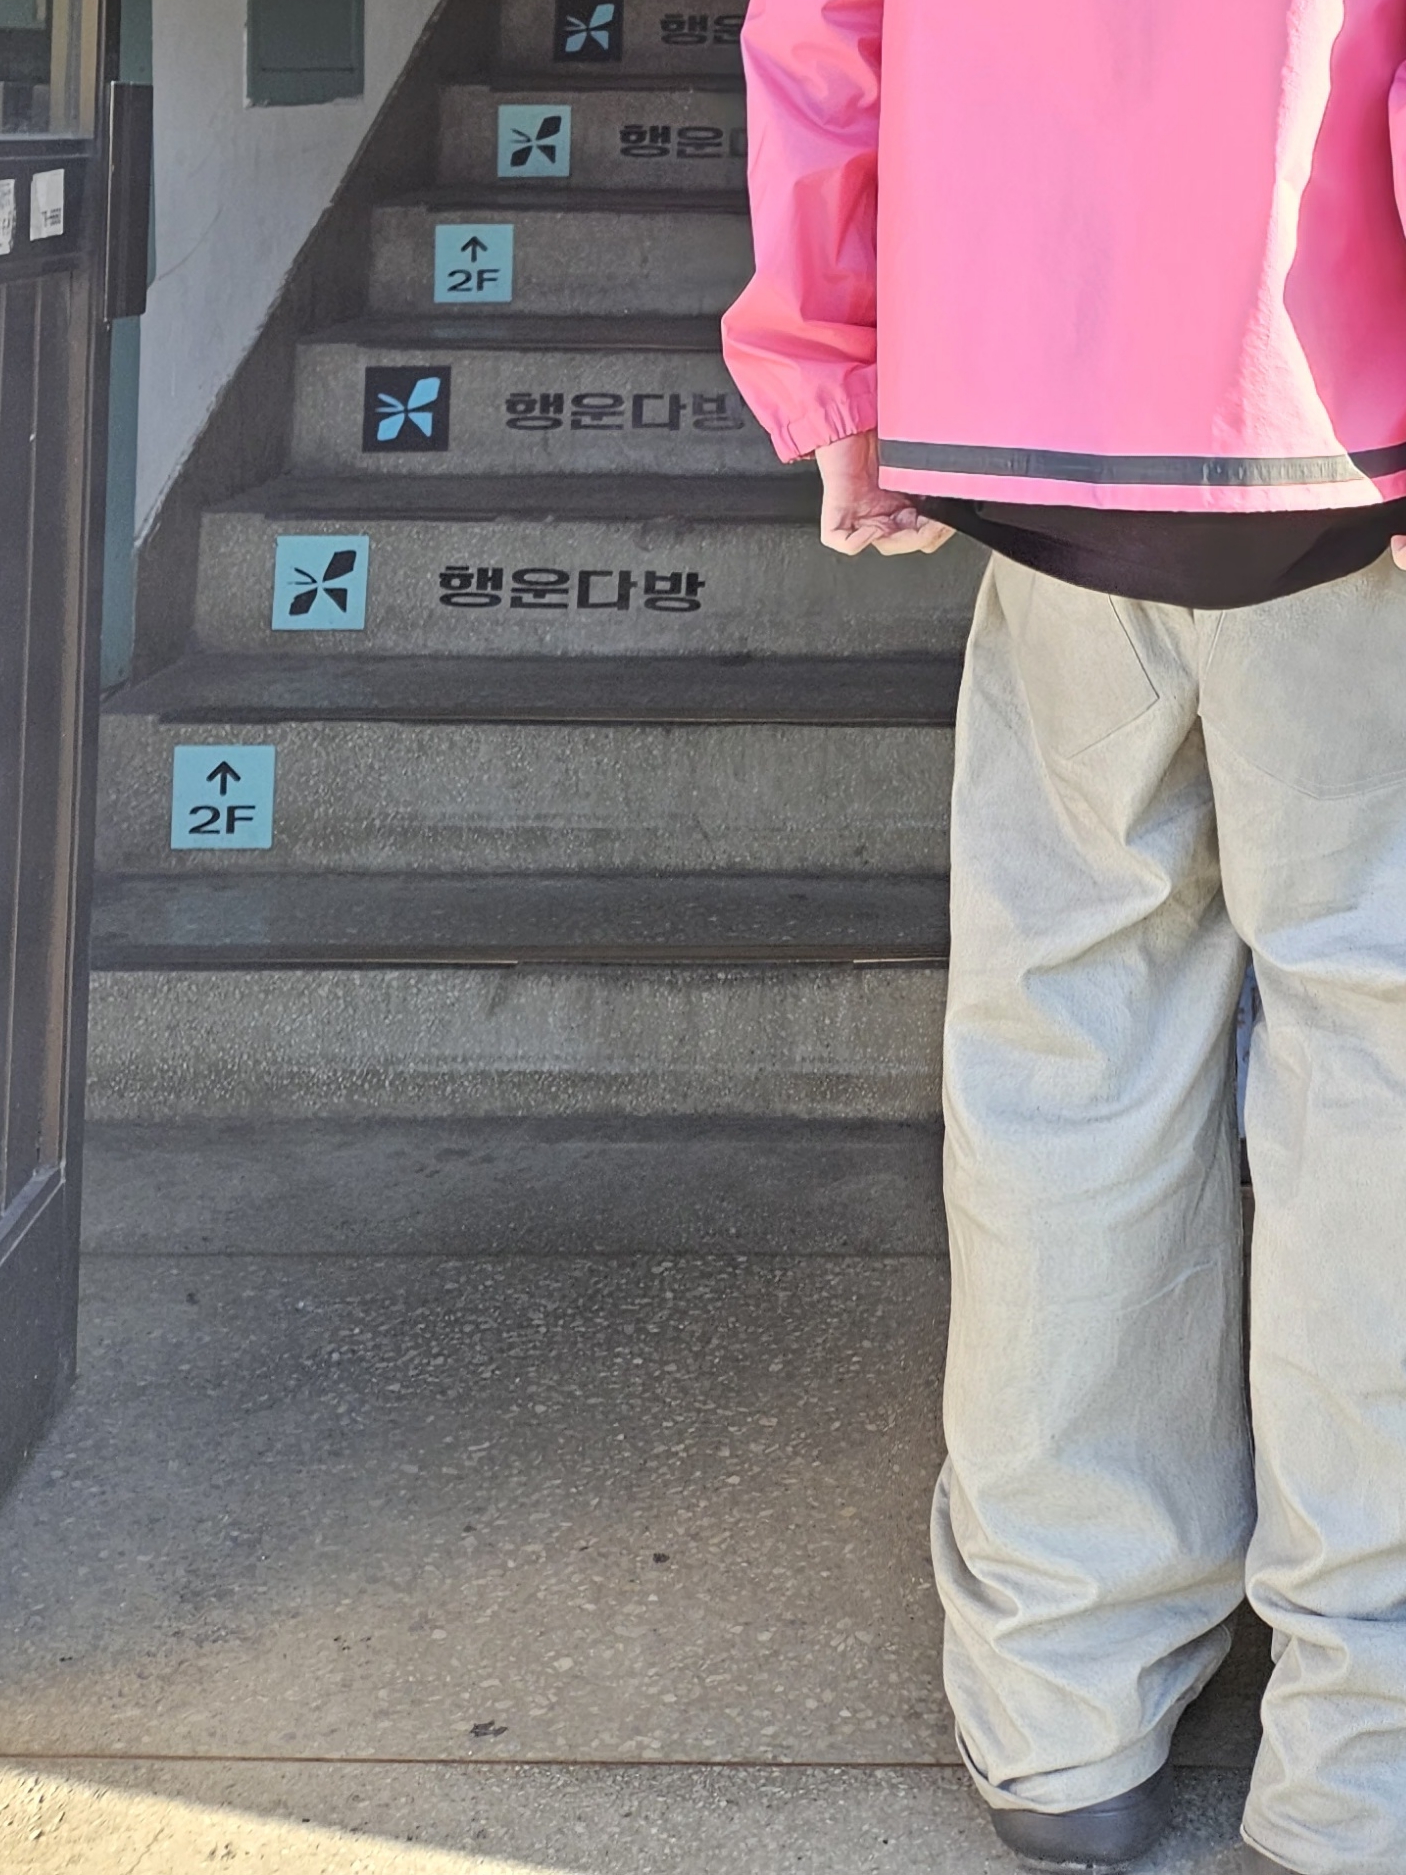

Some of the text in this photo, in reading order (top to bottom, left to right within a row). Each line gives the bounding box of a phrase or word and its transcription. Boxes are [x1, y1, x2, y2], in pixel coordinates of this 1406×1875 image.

[446, 268, 500, 293] 2F
[505, 392, 746, 431] 행운다방
[438, 565, 706, 613] 행운다방
[188, 805, 257, 836] 2F
